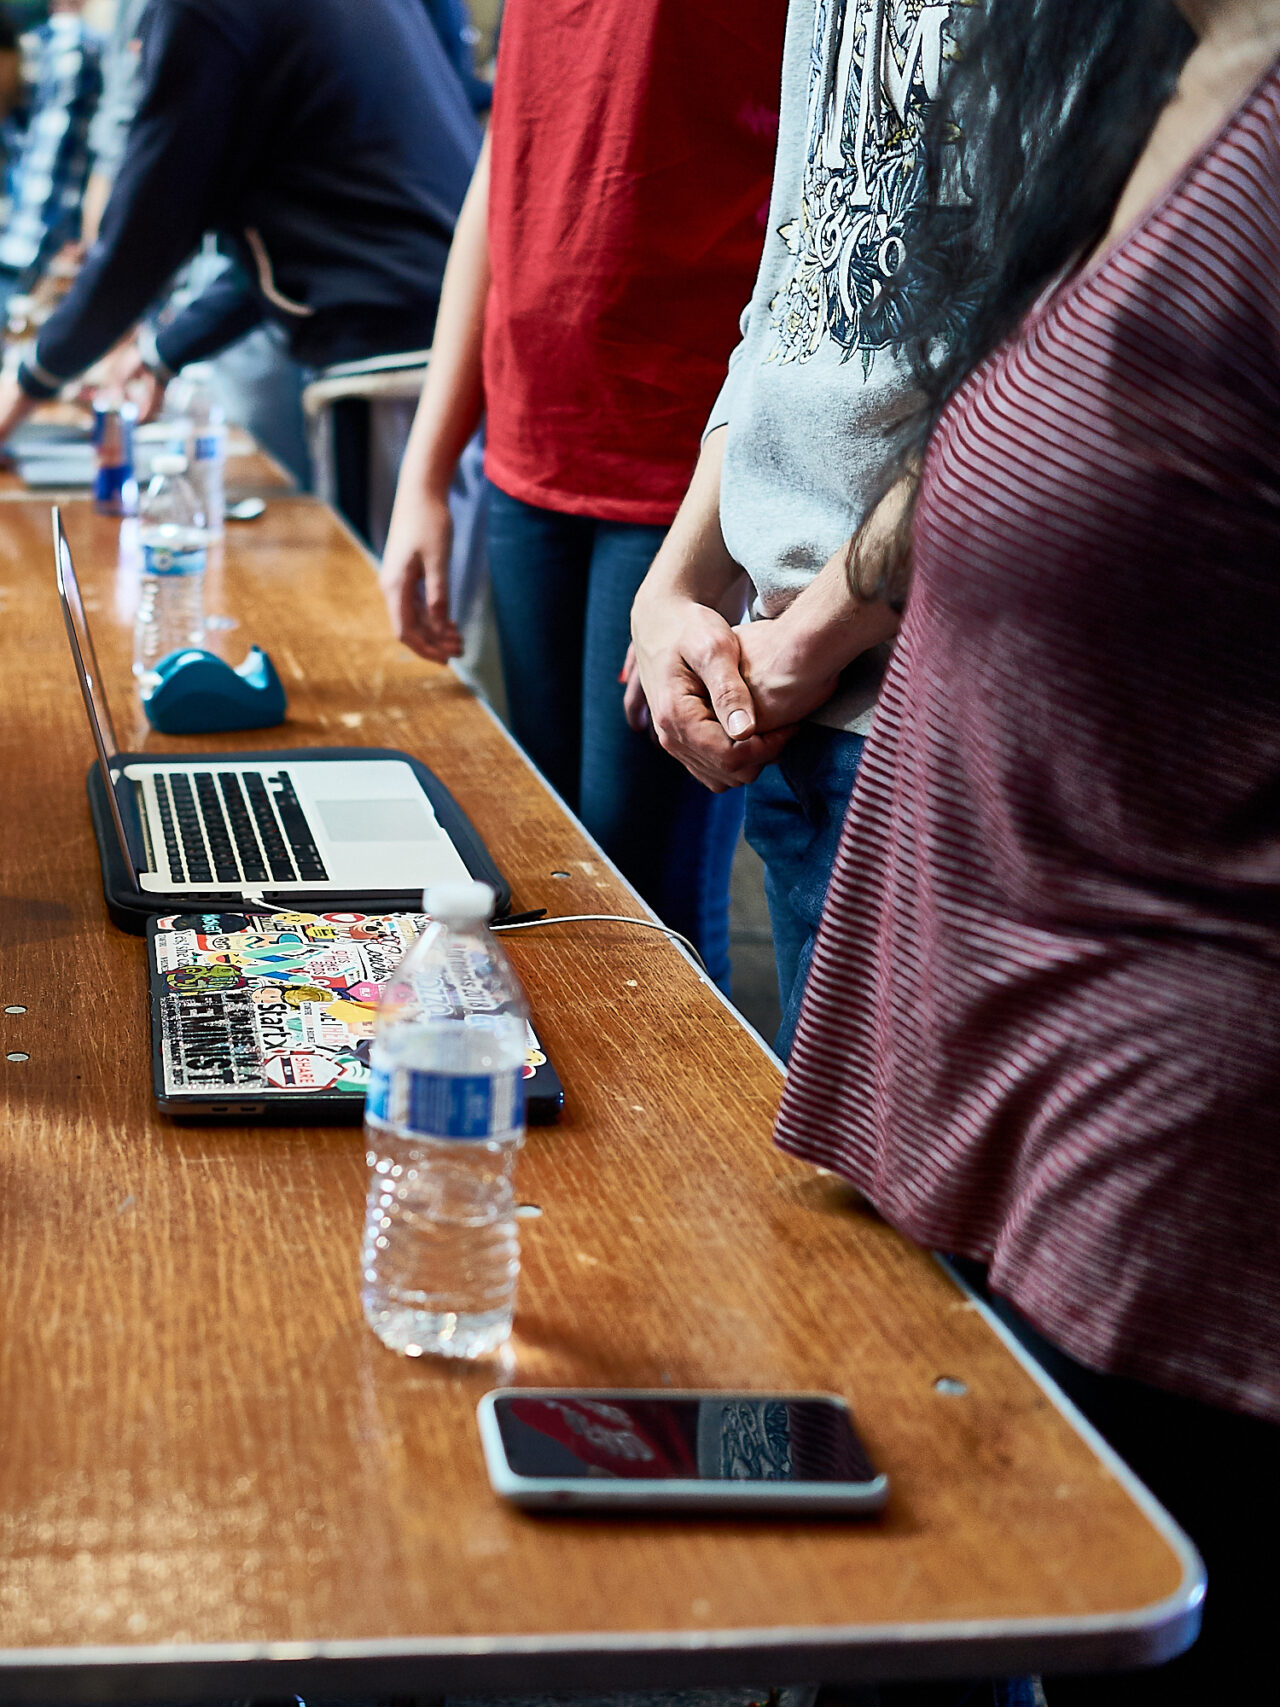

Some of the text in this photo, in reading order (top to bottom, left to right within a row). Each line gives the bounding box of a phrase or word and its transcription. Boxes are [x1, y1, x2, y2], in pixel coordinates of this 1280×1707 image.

[179, 994, 234, 1085] FEMINIST
[228, 1009, 256, 1047] COURSE
[294, 1058, 315, 1084] SHARE
